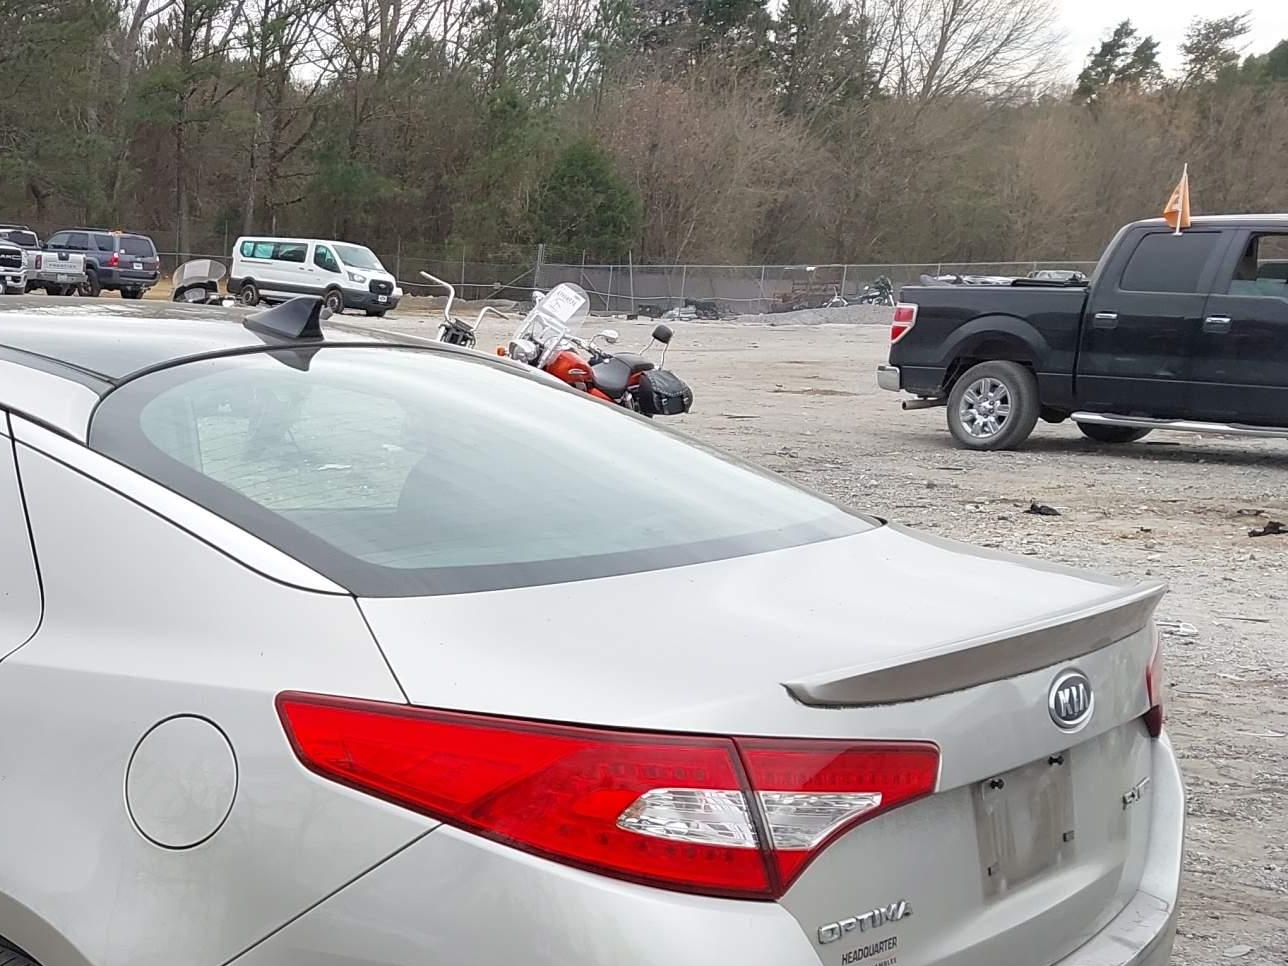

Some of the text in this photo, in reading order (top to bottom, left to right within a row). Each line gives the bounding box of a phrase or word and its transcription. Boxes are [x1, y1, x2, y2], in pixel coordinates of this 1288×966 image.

[1057, 683, 1089, 718] KIA
[817, 898, 914, 945] OPTIMA
[841, 936, 898, 966] HEADQUARTER
